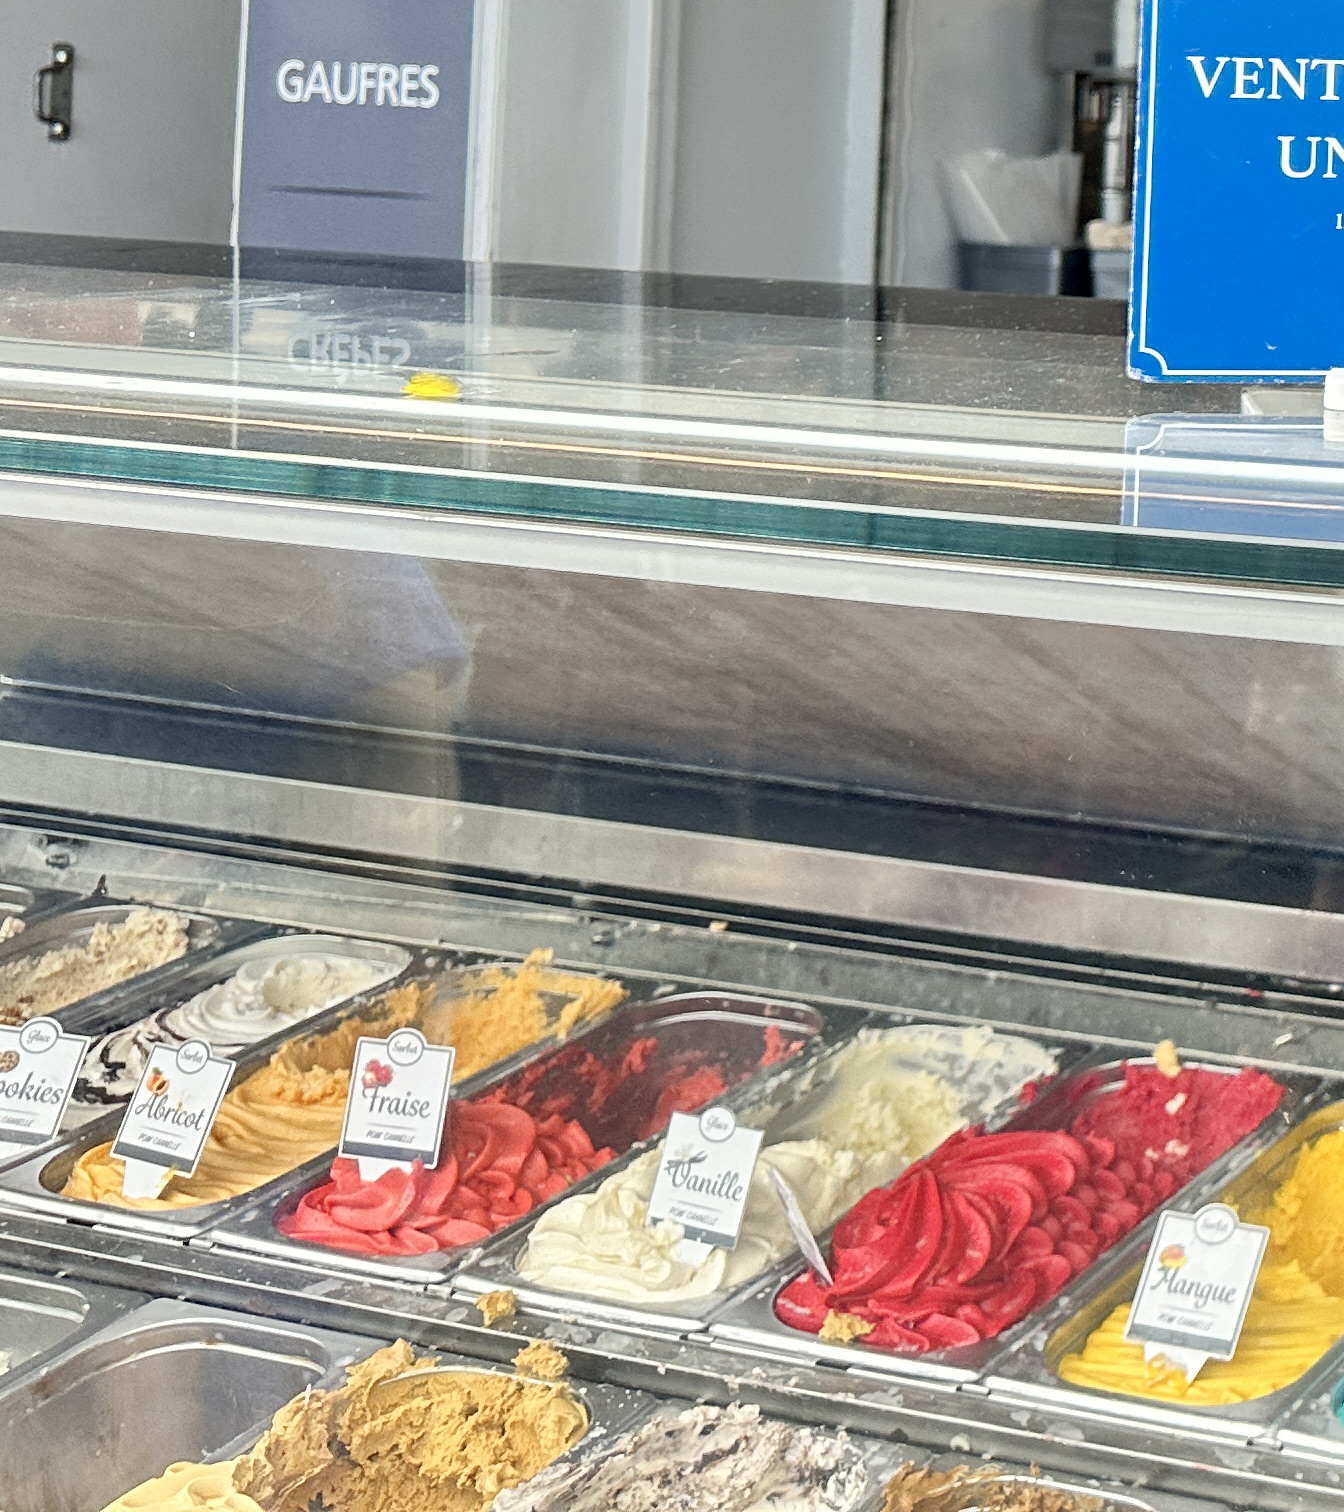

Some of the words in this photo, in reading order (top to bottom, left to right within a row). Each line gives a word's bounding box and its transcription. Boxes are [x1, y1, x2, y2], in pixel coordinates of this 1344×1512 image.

[276, 59, 439, 108] GAUFRES
[135, 1093, 205, 1131] Abricot
[362, 1087, 430, 1119] Fraise
[667, 1162, 743, 1201] Vanille
